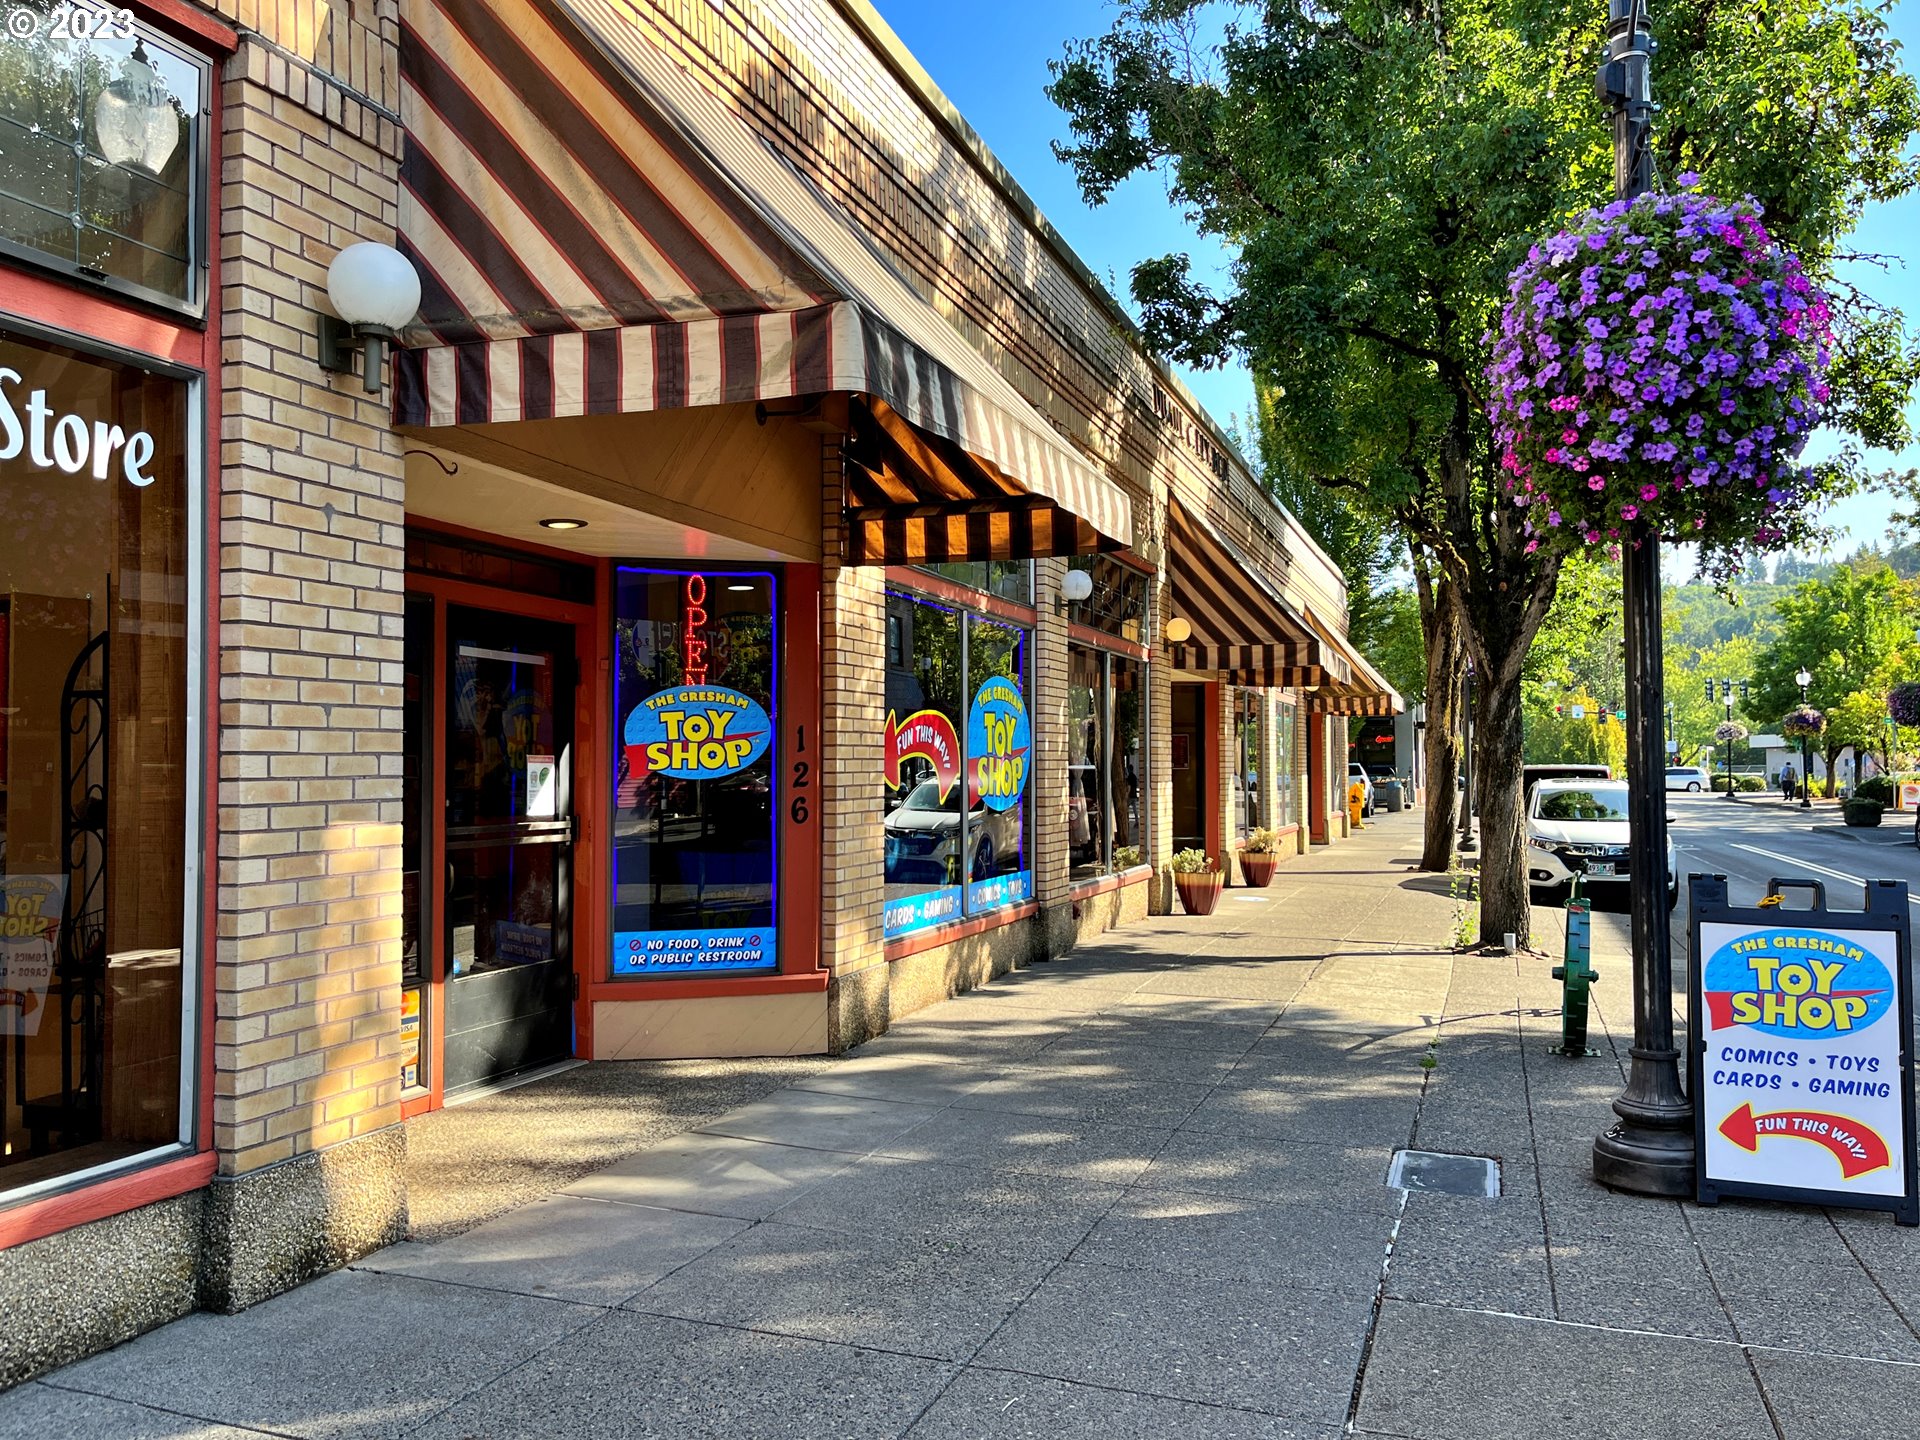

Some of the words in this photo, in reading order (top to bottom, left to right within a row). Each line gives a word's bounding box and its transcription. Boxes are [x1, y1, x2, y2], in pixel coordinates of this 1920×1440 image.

[0, 367, 155, 487] Store
[645, 693, 675, 711] THE
[678, 691, 749, 710] GRESHAM
[978, 688, 992, 708] THE
[993, 686, 1024, 715] GRESHAM
[658, 708, 738, 743] TOY
[983, 711, 1018, 758] TOY
[646, 738, 753, 771] SHOP
[897, 728, 914, 755] FUN
[915, 725, 933, 744] THIS
[934, 730, 951, 769] WAY!
[976, 754, 1023, 799] SHOP
[977, 882, 1001, 905] COMICS
[1008, 879, 1022, 896] TOYS
[885, 904, 915, 929] CARDS
[923, 895, 954, 920] GAMING
[629, 954, 647, 966] OR
[650, 952, 694, 965] PUBLIC
[697, 950, 762, 962] RESTROOM
[646, 939, 664, 951] NO
[667, 938, 703, 950] FOOD,
[708, 937, 746, 949] DRINK
[1731, 937, 1768, 955] THE
[1773, 936, 1865, 963] GRESHAM
[1747, 956, 1848, 997] TOY
[1730, 990, 1869, 1032] SHOP
[1721, 1046, 1799, 1067] COMICS
[1826, 1054, 1880, 1073] TOYS
[1713, 1070, 1782, 1090] CARDS
[1809, 1078, 1891, 1098] GAMING
[1754, 1117, 1787, 1133] FUN
[1792, 1117, 1829, 1136] THIS
[1831, 1126, 1868, 1160] WAY!
